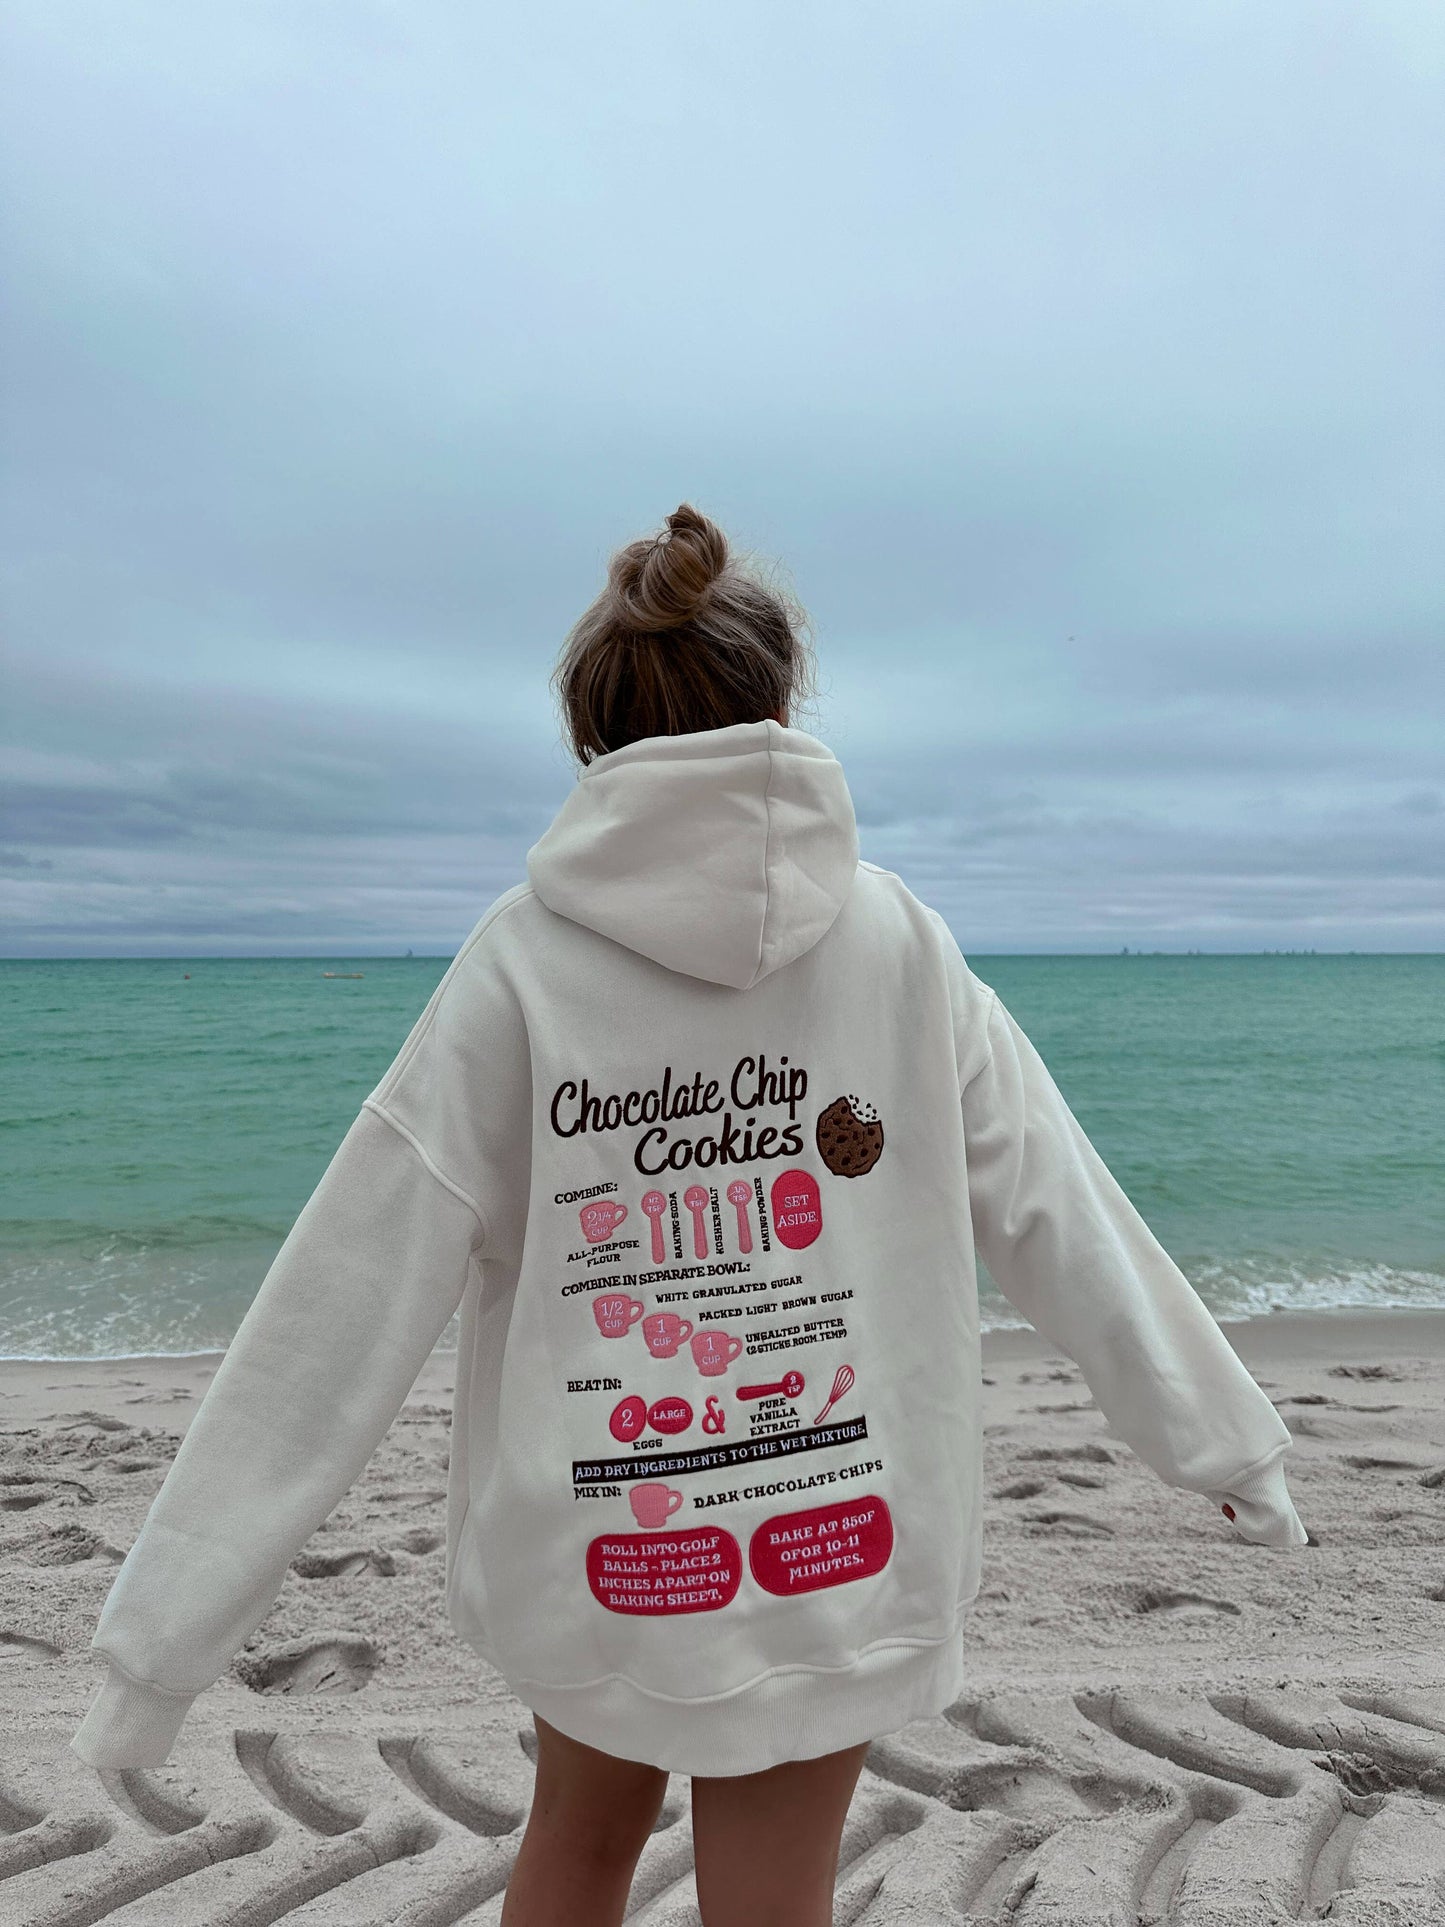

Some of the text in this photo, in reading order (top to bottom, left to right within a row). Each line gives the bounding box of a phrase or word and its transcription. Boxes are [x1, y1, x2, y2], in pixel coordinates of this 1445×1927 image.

[550, 1054, 808, 1138] Chocolate Chip
[634, 1112, 804, 1175] Cookies
[554, 1182, 618, 1204] COMBINE:
[784, 1194, 809, 1208] SET
[710, 1187, 724, 1254] KOSHER SALT
[754, 1177, 770, 1251] BAKING POWDER
[591, 1226, 609, 1237] CUP
[669, 1192, 683, 1259] BAKING SODA
[567, 1240, 640, 1262] ALL-PURPOSE
[587, 1253, 621, 1267] FLOUR
[561, 1262, 750, 1296] COMBINE IN SEPARATE BOWL:
[656, 1276, 803, 1304] WHITE GRANULATED SUGAR
[601, 1300, 624, 1318] 1/2
[699, 1290, 854, 1322] PACKED LIGHT BROWN SUGAR
[604, 1320, 623, 1328] CUP
[656, 1319, 666, 1333] 1
[745, 1318, 844, 1343] UNSALTED BUTTER
[653, 1337, 672, 1346] CUP
[706, 1336, 715, 1351] 1
[819, 1328, 847, 1342] TEMP)
[702, 1355, 721, 1365] CUP
[567, 1378, 622, 1392] BEAT IN:
[787, 1385, 801, 1393] TSP
[653, 1408, 686, 1420] LARGE
[702, 1394, 725, 1434] &
[758, 1398, 786, 1411] PURE
[621, 1408, 634, 1428] 2
[750, 1407, 798, 1424] VANILLA
[750, 1419, 801, 1437] EXTRACT
[632, 1438, 663, 1450] EGGS
[575, 1466, 601, 1480] ADD
[604, 1465, 630, 1477] DRY
[631, 1451, 726, 1475] INGREDIENTS
[730, 1447, 748, 1460] TO
[750, 1441, 778, 1457] THE
[779, 1435, 808, 1452] WET
[693, 1459, 883, 1508] DARK CHOCOLATE CHIPS
[574, 1487, 601, 1500] MIX
[769, 1527, 813, 1545] BAKE
[817, 1520, 838, 1536] AT
[601, 1536, 720, 1556] ROLL INTO GOLF
[826, 1534, 860, 1554] 10-11
[603, 1560, 649, 1572] BALLS
[660, 1555, 710, 1571] PLACE
[712, 1553, 721, 1564] 2
[789, 1553, 864, 1580] MINUTES.
[599, 1569, 731, 1589] INCHES APART ON
[609, 1588, 722, 1606] BAKING SHEET.
